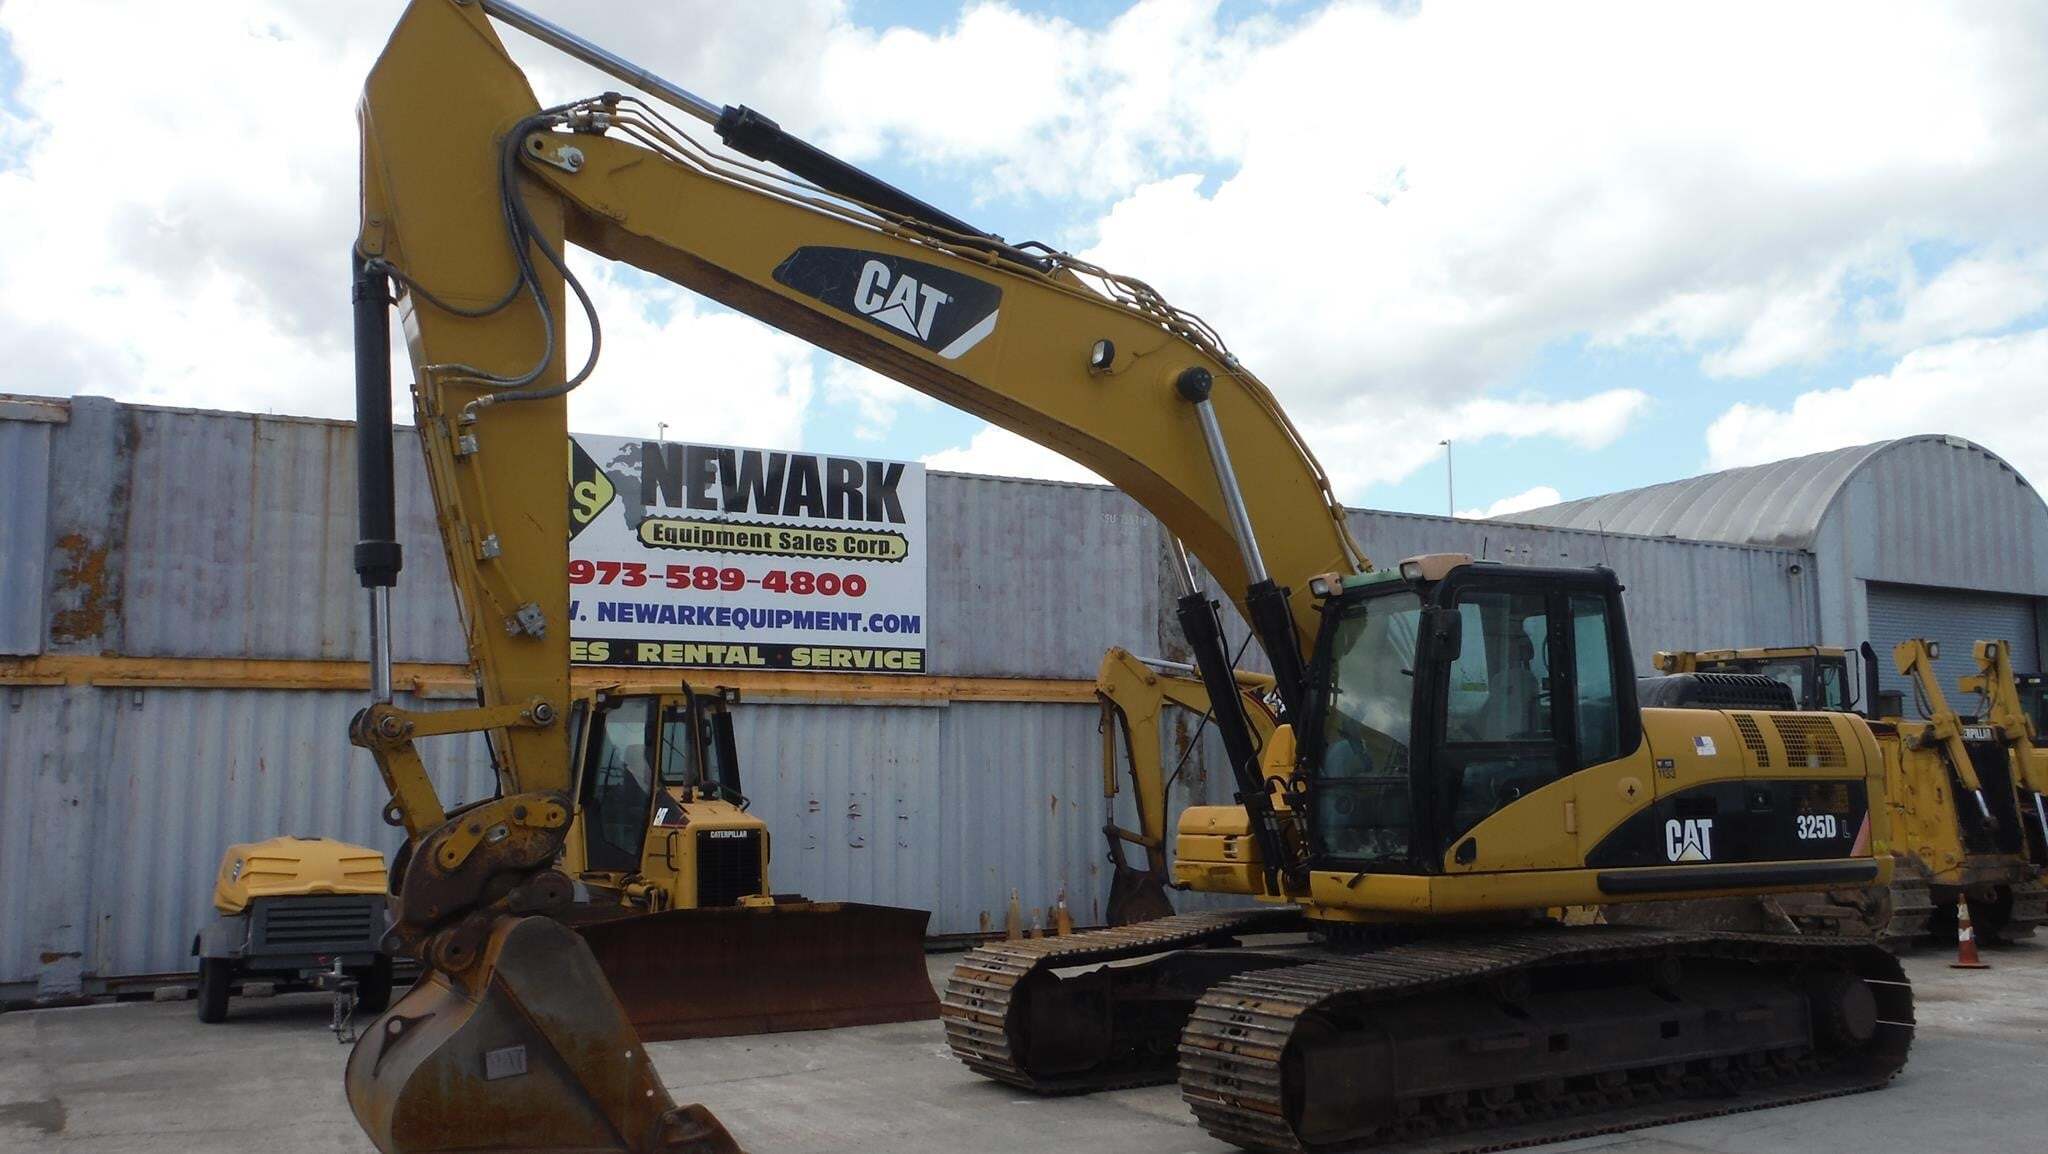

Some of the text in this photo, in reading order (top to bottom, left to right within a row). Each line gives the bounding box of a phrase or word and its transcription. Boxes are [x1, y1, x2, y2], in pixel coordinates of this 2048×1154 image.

[854, 260, 948, 341] CAT
[640, 441, 906, 524] NEWARK
[653, 523, 896, 556] Equipment Sales Corp.
[568, 559, 867, 597] 973-589-4800
[598, 601, 921, 634] NEWARKEQUIPMENT.COM
[570, 641, 921, 670] ES RENTAL SERVICE
[710, 830, 748, 839] CATERPILLAR
[1665, 818, 1713, 861] CAT
[1797, 814, 1837, 840] 325D
